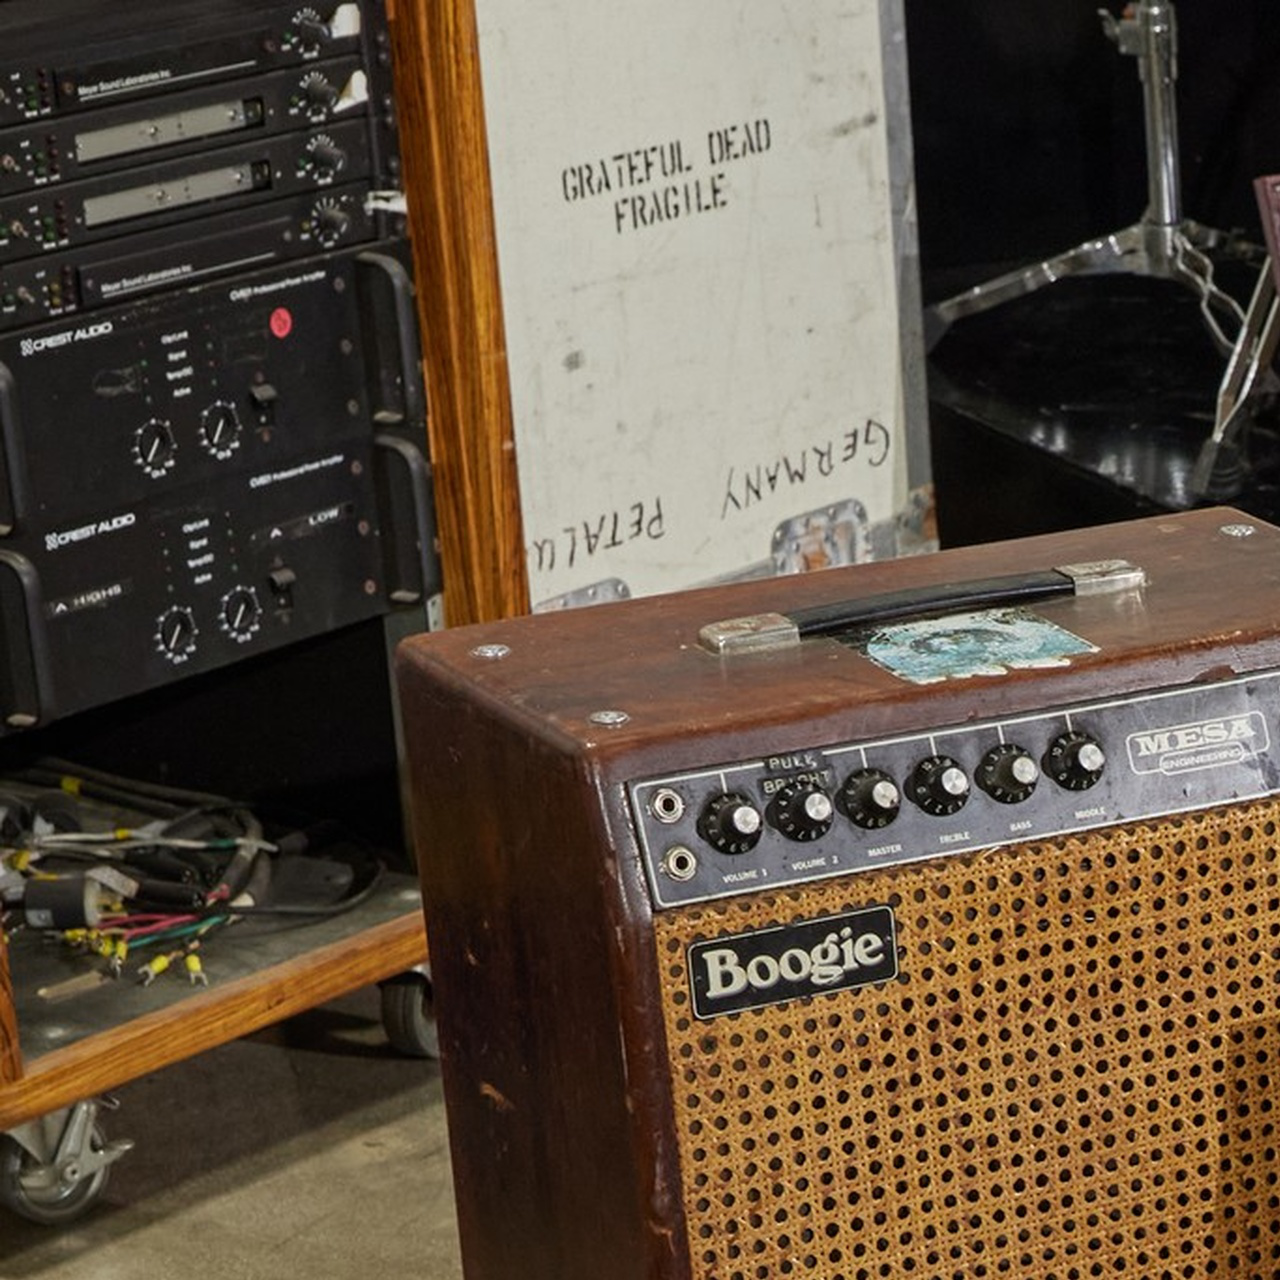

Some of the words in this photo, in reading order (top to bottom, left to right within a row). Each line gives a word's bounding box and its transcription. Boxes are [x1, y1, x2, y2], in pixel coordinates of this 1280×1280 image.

[562, 140, 692, 203] GRATEFUL
[708, 118, 771, 166] DEAD
[614, 173, 728, 234] FRAGILE
[33, 329, 73, 352] CREST
[74, 321, 113, 341] AUDIO
[722, 418, 890, 519] GERMANY
[58, 525, 97, 545] CREST
[98, 513, 136, 534] AUDIO
[1135, 714, 1255, 756] MESA
[791, 858, 826, 871] VOLUME
[868, 843, 902, 858] MASTER
[722, 870, 758, 884] VOLUME
[701, 926, 885, 999] Boogie
